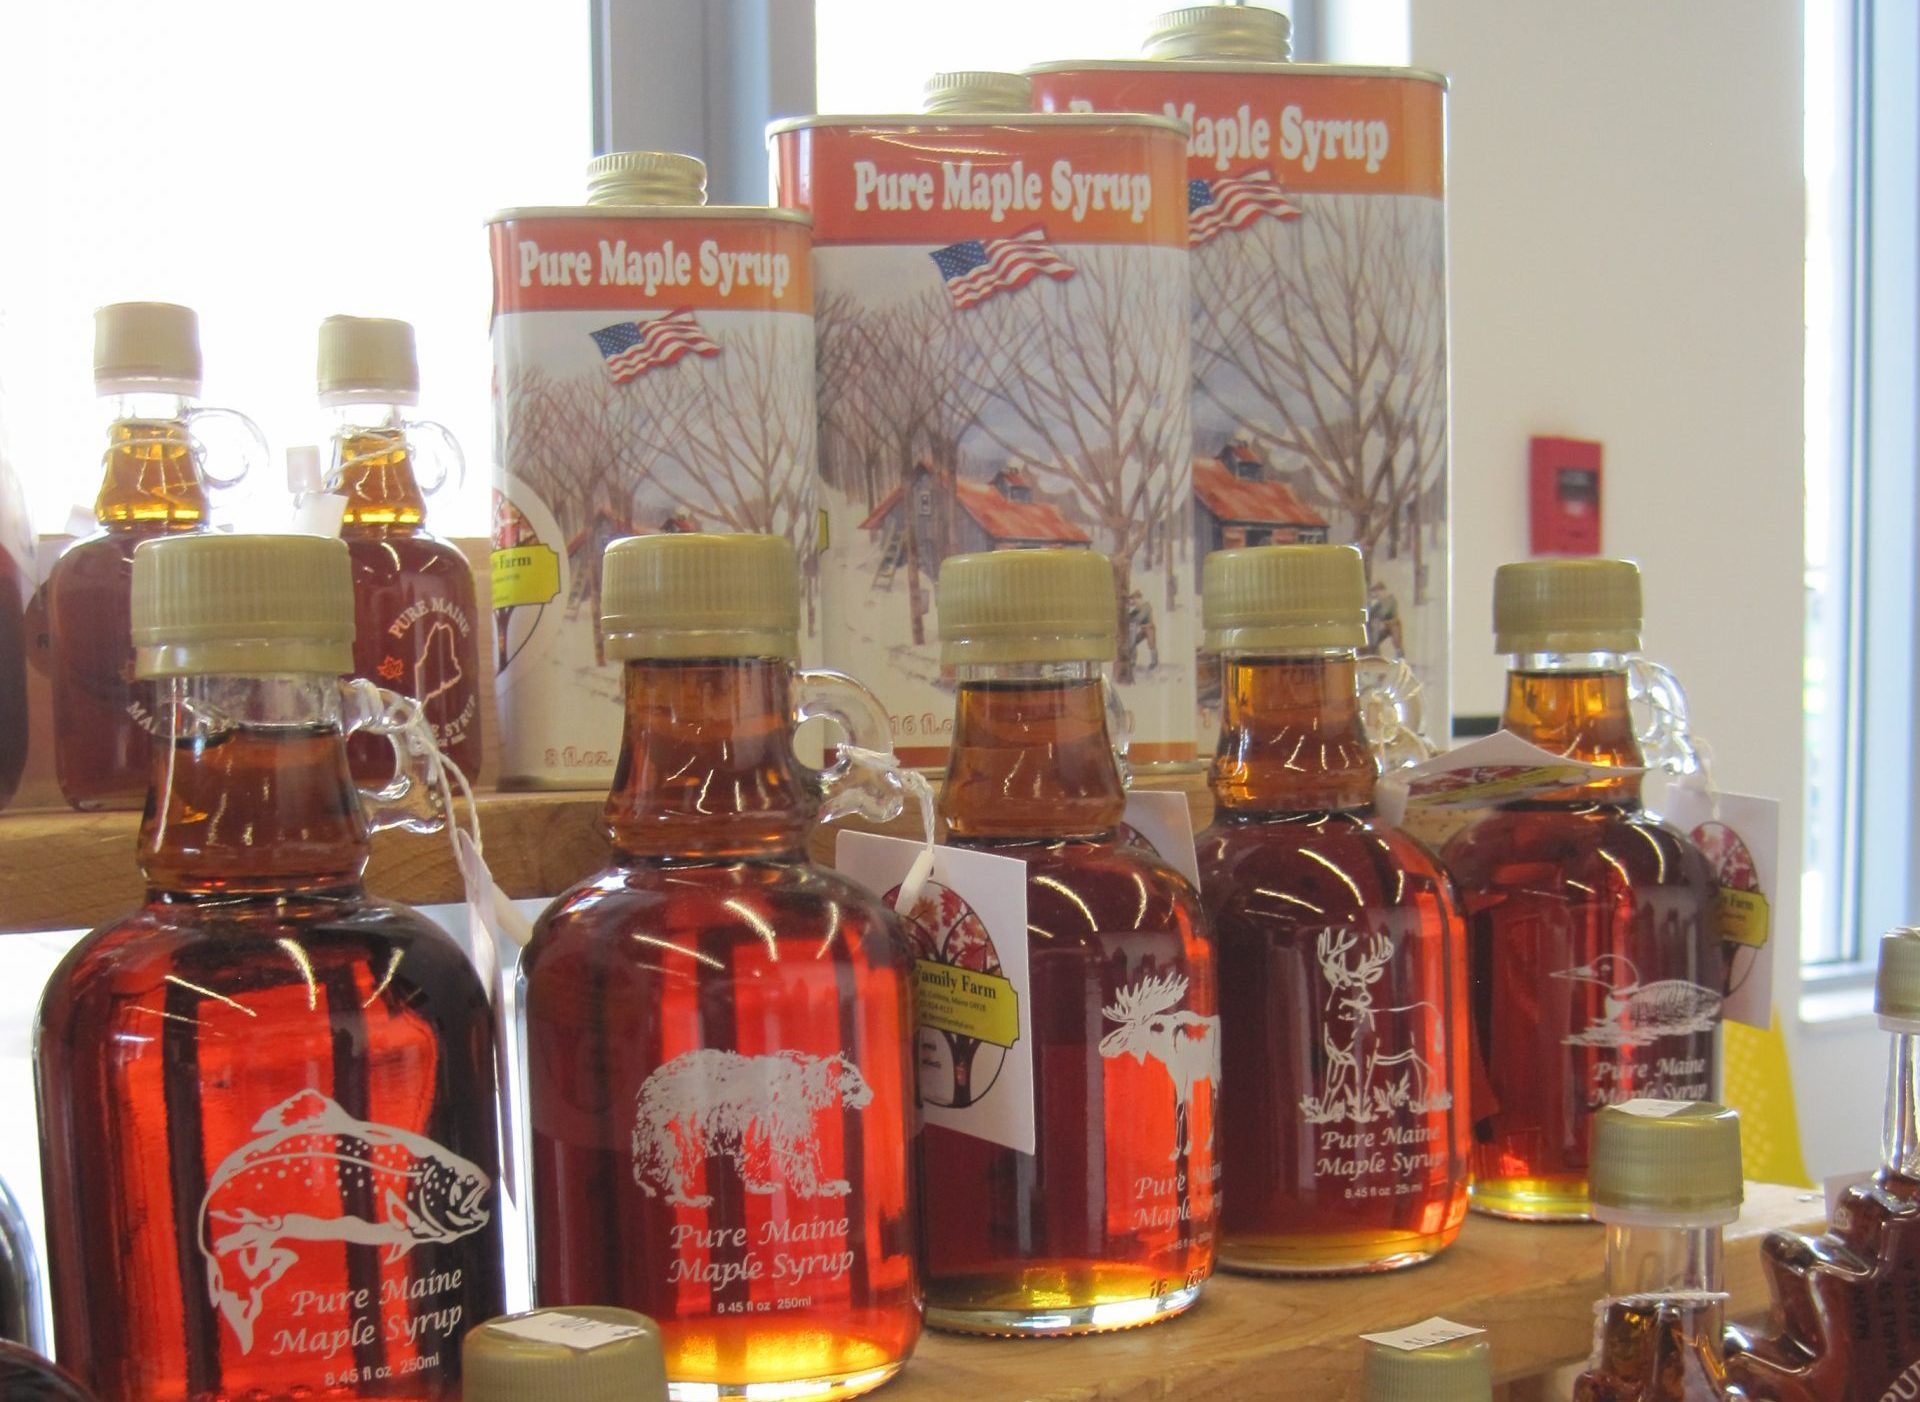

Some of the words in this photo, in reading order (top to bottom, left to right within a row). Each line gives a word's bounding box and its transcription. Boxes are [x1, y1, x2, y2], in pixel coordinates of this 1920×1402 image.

[1280, 105, 1389, 173] Syrup
[854, 161, 933, 211] Pure
[942, 161, 1043, 222] Maple
[1051, 160, 1151, 224] Syrup
[519, 240, 590, 287] Pure
[599, 240, 691, 297] Maple
[699, 240, 790, 298] Syrup
[388, 600, 429, 639] PURE
[888, 714, 917, 736] 16
[545, 747, 558, 768] 8
[919, 967, 958, 994] amily
[961, 974, 996, 999] Farm
[1592, 1062, 1648, 1081] Pure
[1654, 1057, 1706, 1077] Maine
[1321, 1131, 1375, 1150] Pure
[1380, 1124, 1440, 1146] Maine
[1314, 1152, 1386, 1181] Maple
[1134, 1174, 1186, 1199] Pure
[1131, 1196, 1192, 1232] Maple
[670, 1223, 747, 1250] Pure
[758, 1215, 850, 1245] Maine
[667, 1252, 765, 1292] Maple
[772, 1250, 855, 1286] Syrup
[291, 1286, 369, 1318] Pure
[378, 1267, 462, 1306] Maine
[717, 1301, 744, 1314] 845
[746, 1301, 754, 1312] fl
[756, 1302, 771, 1312] oz
[777, 1296, 812, 1310] 250ml
[270, 1316, 376, 1361] Maple
[386, 1305, 463, 1348] Syrup
[363, 1366, 372, 1381] fl
[375, 1366, 393, 1379] oz
[400, 1352, 439, 1375] 250ml
